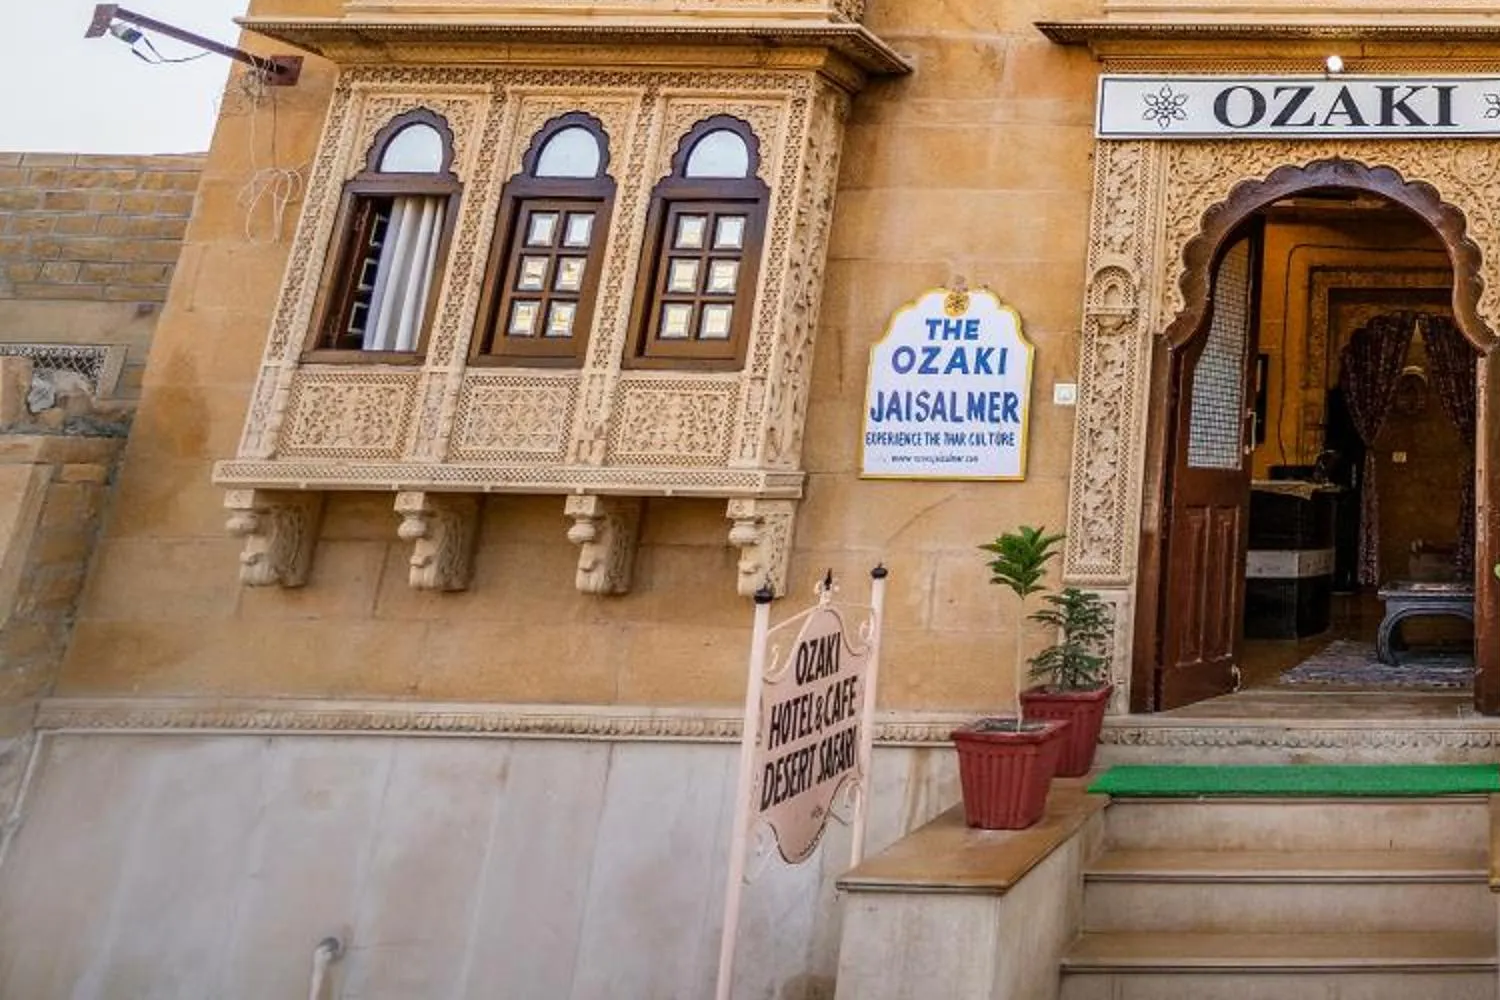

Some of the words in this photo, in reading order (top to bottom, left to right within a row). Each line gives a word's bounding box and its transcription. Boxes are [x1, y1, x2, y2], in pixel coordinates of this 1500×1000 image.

[1213, 85, 1461, 128] OZAKI
[925, 318, 980, 340] THE
[891, 346, 1008, 375] OZAKI
[870, 391, 1020, 423] JAISALMER
[865, 431, 922, 447] EXPERIENCE
[925, 432, 940, 446] THE
[795, 631, 841, 686] OZAKI
[767, 692, 814, 751] HOTEL
[824, 675, 858, 726] CAFE
[759, 743, 817, 812] DESERT
[816, 724, 857, 784] SAFARI
